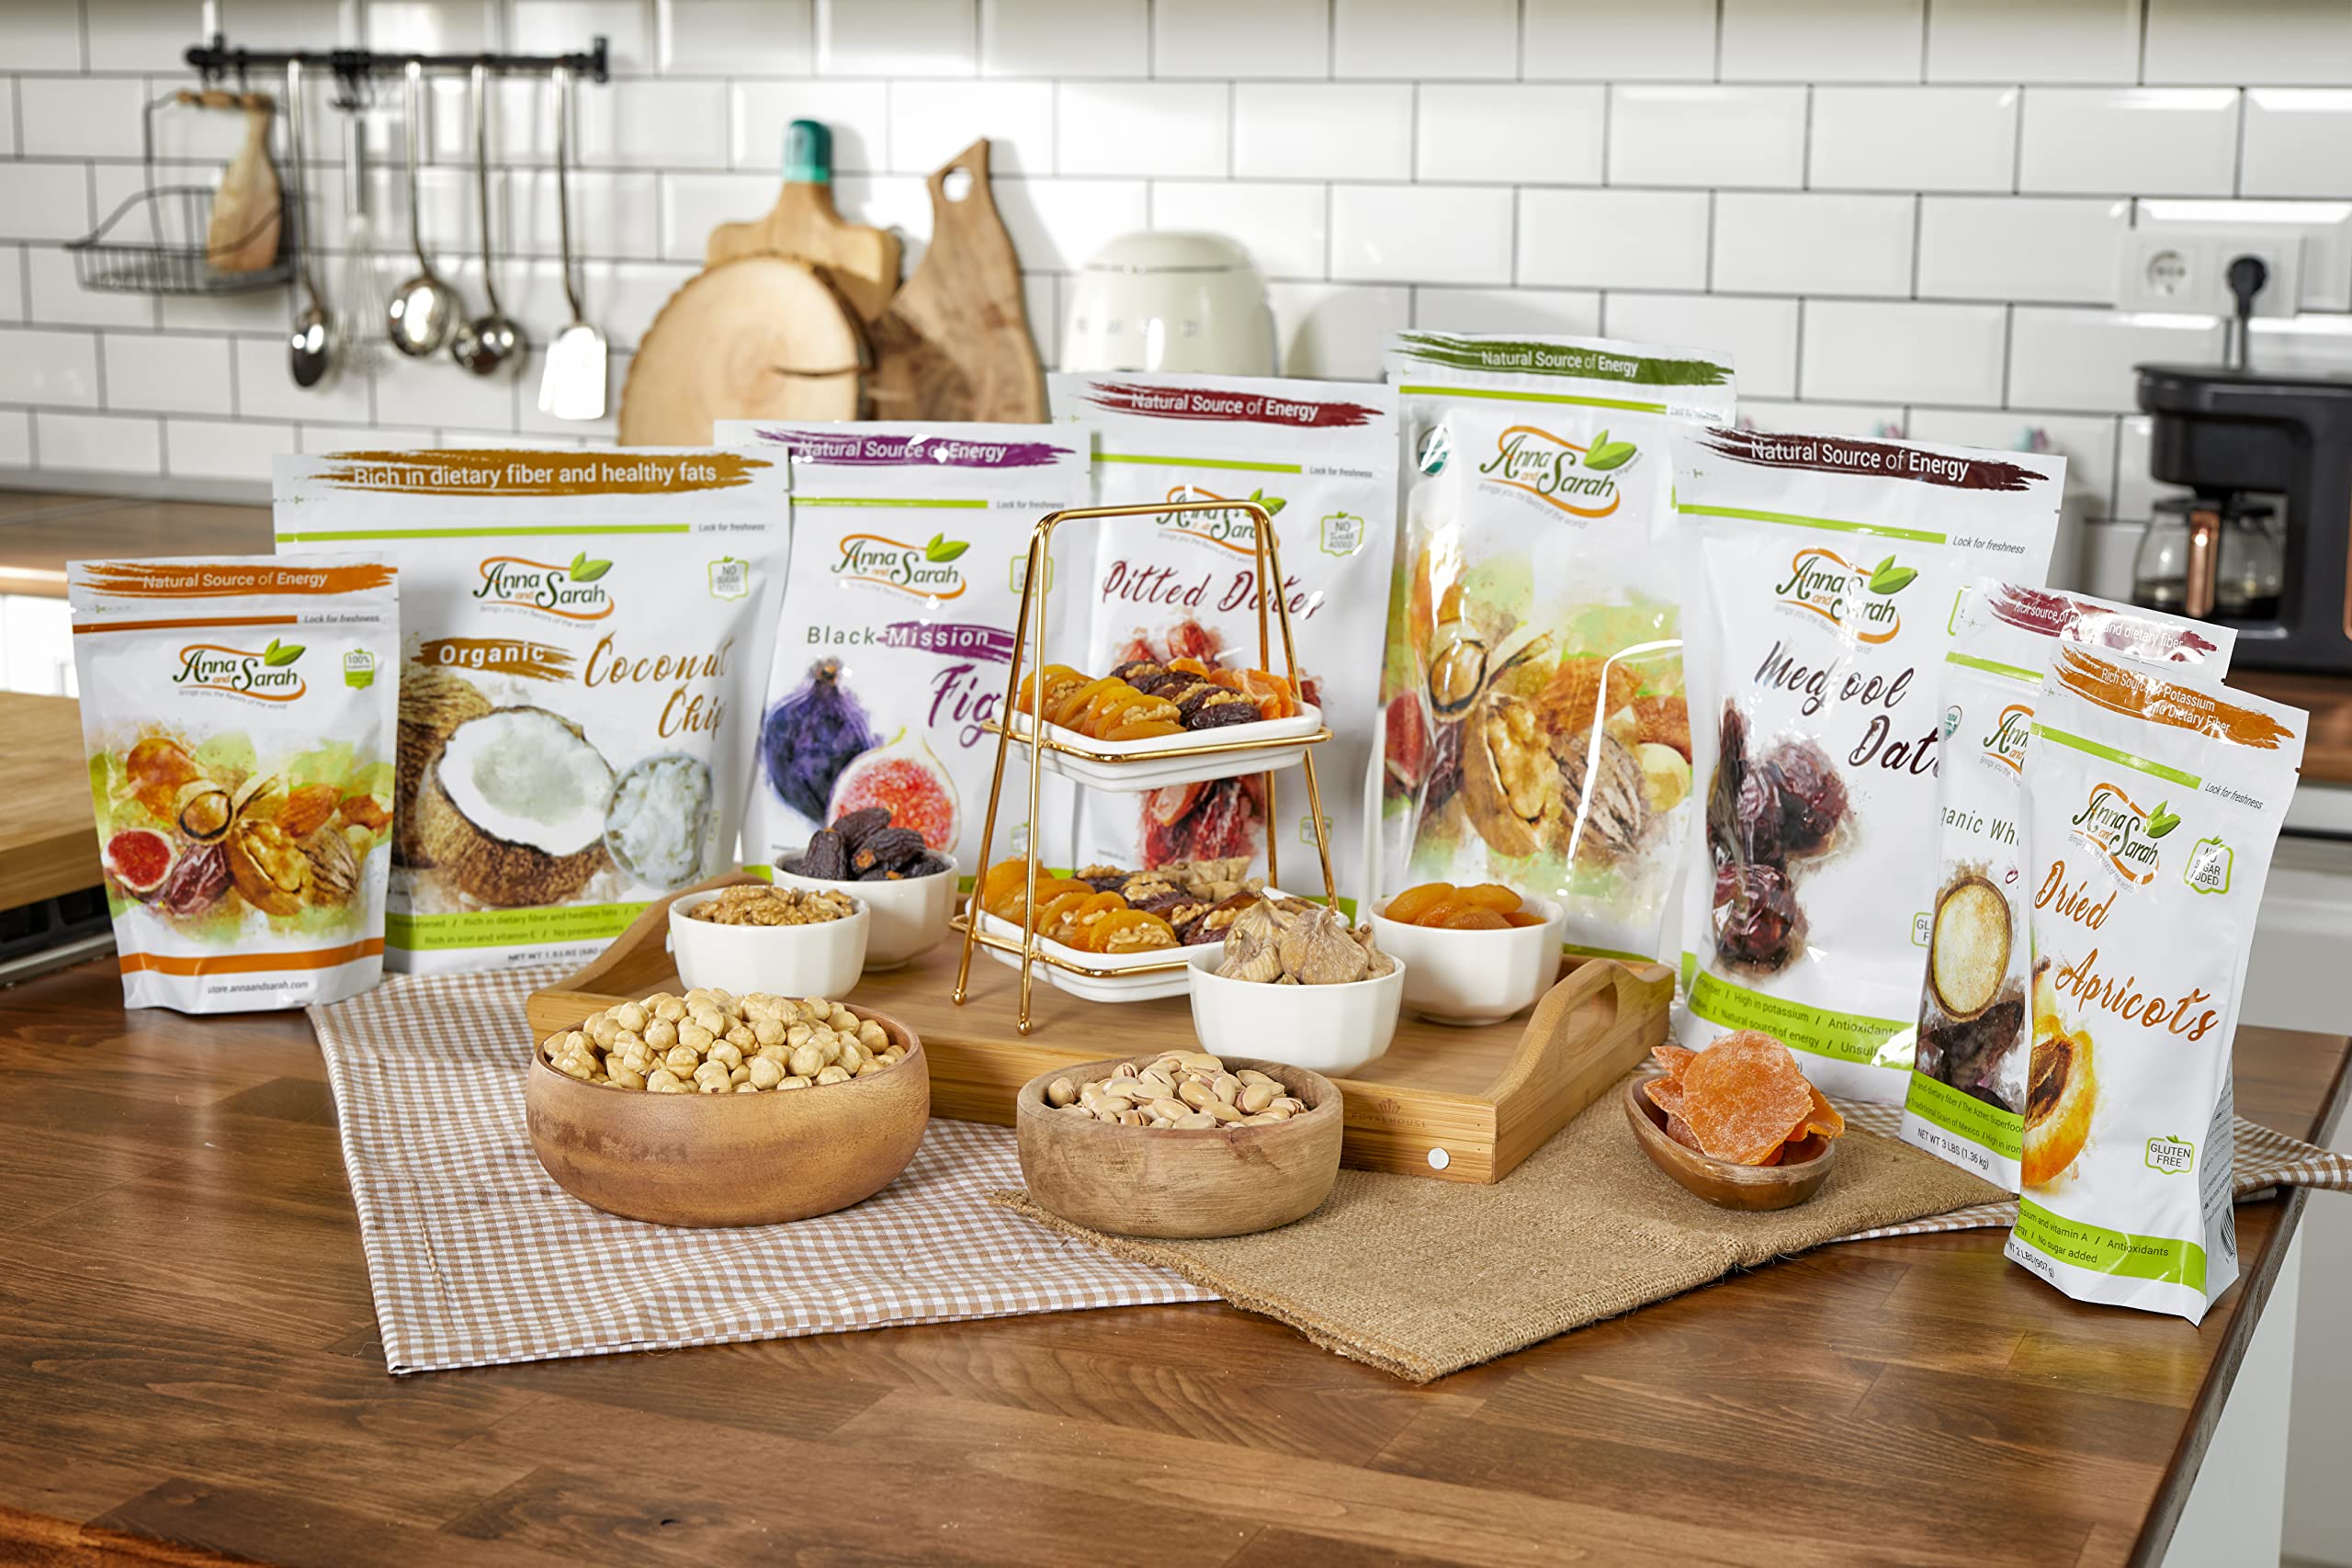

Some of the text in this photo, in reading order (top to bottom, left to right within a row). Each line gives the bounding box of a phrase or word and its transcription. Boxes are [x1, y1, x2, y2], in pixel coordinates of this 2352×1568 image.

[1481, 350, 1638, 378] Natural Source of Energy
[1131, 394, 1318, 422] Natural Source of Energy
[798, 441, 862, 458] Natural
[865, 441, 923, 459] Source
[949, 443, 1006, 462] Energy
[1479, 434, 1551, 479] Anna
[1536, 452, 1615, 497] Sarah
[1751, 441, 1969, 481] Natural Source of Energy
[354, 462, 717, 489] Rich in dietary fiber and healthy fats
[1309, 467, 1373, 478] Lock for freshness
[997, 501, 1065, 510] Lock for freshness
[1335, 521, 1351, 531] NO
[1952, 536, 2025, 554] Lock for freshness
[831, 540, 896, 574] Anna
[890, 551, 957, 585] Sarah
[143, 572, 328, 589] Natural Source of Energy
[473, 562, 539, 599] Anna
[536, 571, 605, 609] Sarah
[1102, 560, 1211, 607] Pitted
[1775, 557, 1846, 600] Anna
[1812, 594, 1834, 606] and
[304, 615, 379, 624] Lock for freshness
[2030, 606, 2058, 621] source
[2059, 611, 2069, 622] of
[808, 626, 989, 647] Black Mission
[2124, 624, 2158, 649] dietary
[2161, 635, 2183, 649] fiber
[439, 642, 545, 668] Organic
[173, 649, 297, 692] Anna and Sarah
[2102, 669, 2119, 684] Rich
[2164, 686, 2215, 712] Potassium
[2168, 705, 2204, 728] Dietary
[2205, 782, 2264, 809] Lock for freshness
[2072, 792, 2158, 865] Anna and Sarah
[2195, 860, 2221, 875] SGAR
[2035, 860, 2117, 930] Dried
[208, 980, 309, 994] store.annaandsarah.com
[2055, 948, 2219, 1042] Apricots
[1735, 993, 1752, 1008] High
[1754, 1000, 1761, 1009] in
[1762, 1002, 1809, 1022] potassium
[1721, 1010, 1748, 1026] Natural
[1749, 1020, 1777, 1035] source
[1779, 1028, 1787, 1038] of
[1789, 1032, 1819, 1049] energy
[1928, 1086, 1945, 1102] dietary
[1945, 1094, 1958, 1109] fiber
[1962, 1101, 1973, 1114] The
[1973, 1110, 1989, 1122] Aztec
[1911, 1097, 1937, 1118] Traditional
[1937, 1110, 1951, 1124] Grain
[1959, 1120, 1980, 1137] Mexico
[1985, 1133, 1998, 1147] High
[1998, 1138, 2005, 1148] in
[2006, 1140, 2021, 1155] iron
[1917, 1127, 1929, 1142] NET
[1929, 1133, 1940, 1147] WT
[1941, 1139, 1947, 1149] 3
[1948, 1141, 1961, 1156] LBS
[1979, 1156, 1989, 1171] kg)
[2150, 1143, 2191, 1158] GLUTEN
[2156, 1155, 2182, 1168] FREE
[2038, 1216, 2049, 1229] and
[2050, 1222, 2079, 1240] vitamin
[2080, 1232, 2087, 1242] A
[2107, 1239, 2169, 1257] Antioxidants
[2038, 1234, 2098, 1264] No sugar added
